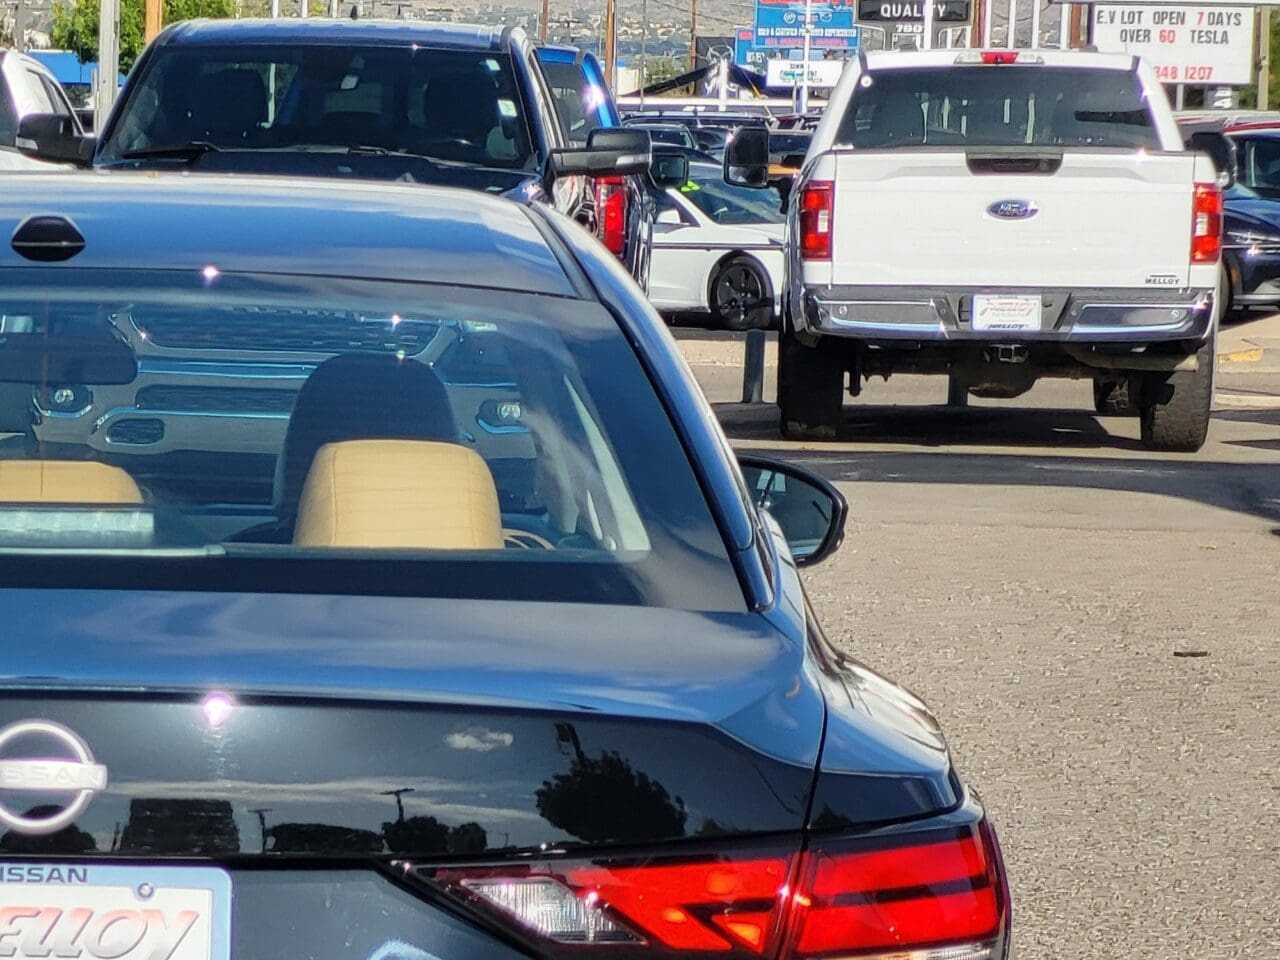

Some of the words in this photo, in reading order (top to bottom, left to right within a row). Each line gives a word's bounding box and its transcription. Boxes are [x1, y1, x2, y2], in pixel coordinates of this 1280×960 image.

[1121, 11, 1144, 25] LOT
[1153, 12, 1185, 26] OPEN
[1197, 12, 1205, 26] 7
[1208, 12, 1242, 26] DAYS
[1120, 30, 1151, 43] OVER
[1159, 29, 1176, 43] 60
[1190, 30, 1229, 44] TESLA
[1184, 66, 1214, 80] 1207
